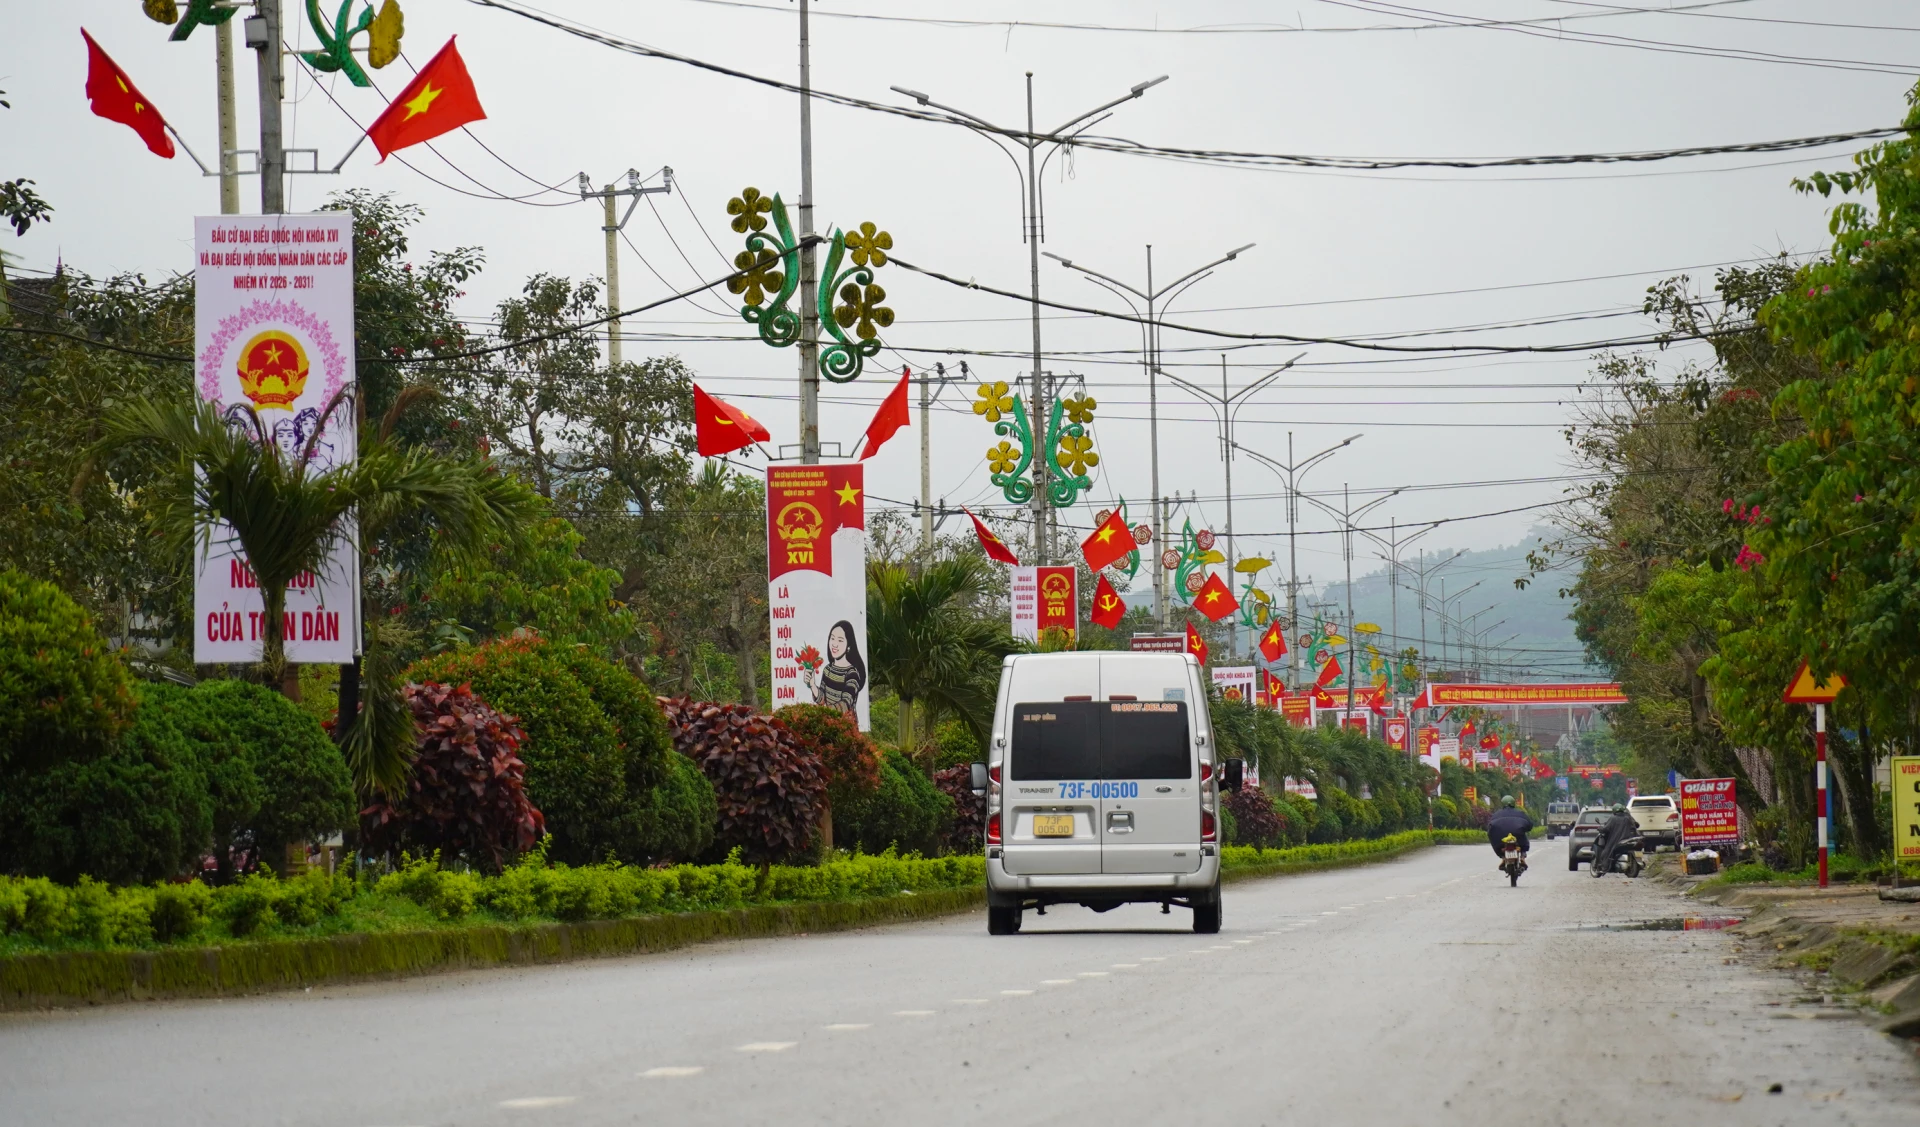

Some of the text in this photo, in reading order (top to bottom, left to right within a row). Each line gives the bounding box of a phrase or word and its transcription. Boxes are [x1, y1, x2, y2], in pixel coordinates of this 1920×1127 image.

[228, 226, 238, 242] CỬ
[240, 229, 251, 246] ĐẠI
[254, 224, 269, 242] BIỂU
[272, 225, 290, 244] QUỐC
[292, 227, 304, 246] HỘI
[306, 226, 325, 242] KHÓA
[327, 229, 338, 242] XVI
[200, 249, 209, 266] VÀ
[212, 252, 223, 268] ĐẠI
[226, 248, 241, 266] BIỂU
[244, 250, 255, 268] HỘI
[279, 250, 298, 266] NHÂN
[300, 250, 314, 266] DÂN
[317, 249, 331, 266] CÁC
[334, 247, 348, 265] CẤP
[234, 273, 256, 292] NHIỆM
[258, 273, 268, 288] KỲ
[270, 276, 287, 288] 2026
[294, 276, 314, 288] 2031!
[787, 551, 814, 564] XVI
[778, 585, 789, 598] LÀ
[772, 604, 796, 618] NGÀY
[1047, 606, 1066, 616] XVI
[208, 602, 244, 642] CỦA
[302, 605, 339, 641] DÂN
[778, 624, 792, 641] HỘI
[776, 643, 793, 658] CỦA
[774, 664, 796, 678] TOÀN
[777, 685, 794, 699] DÂN
[1058, 782, 1138, 798] 73F-00500
[1716, 781, 1732, 791] 37
[1683, 796, 1697, 809] BÚN
[1714, 801, 1722, 809] HÀ
[1724, 800, 1734, 810] NỘI
[1045, 816, 1062, 824] 73F
[1038, 825, 1070, 834] 005.00
